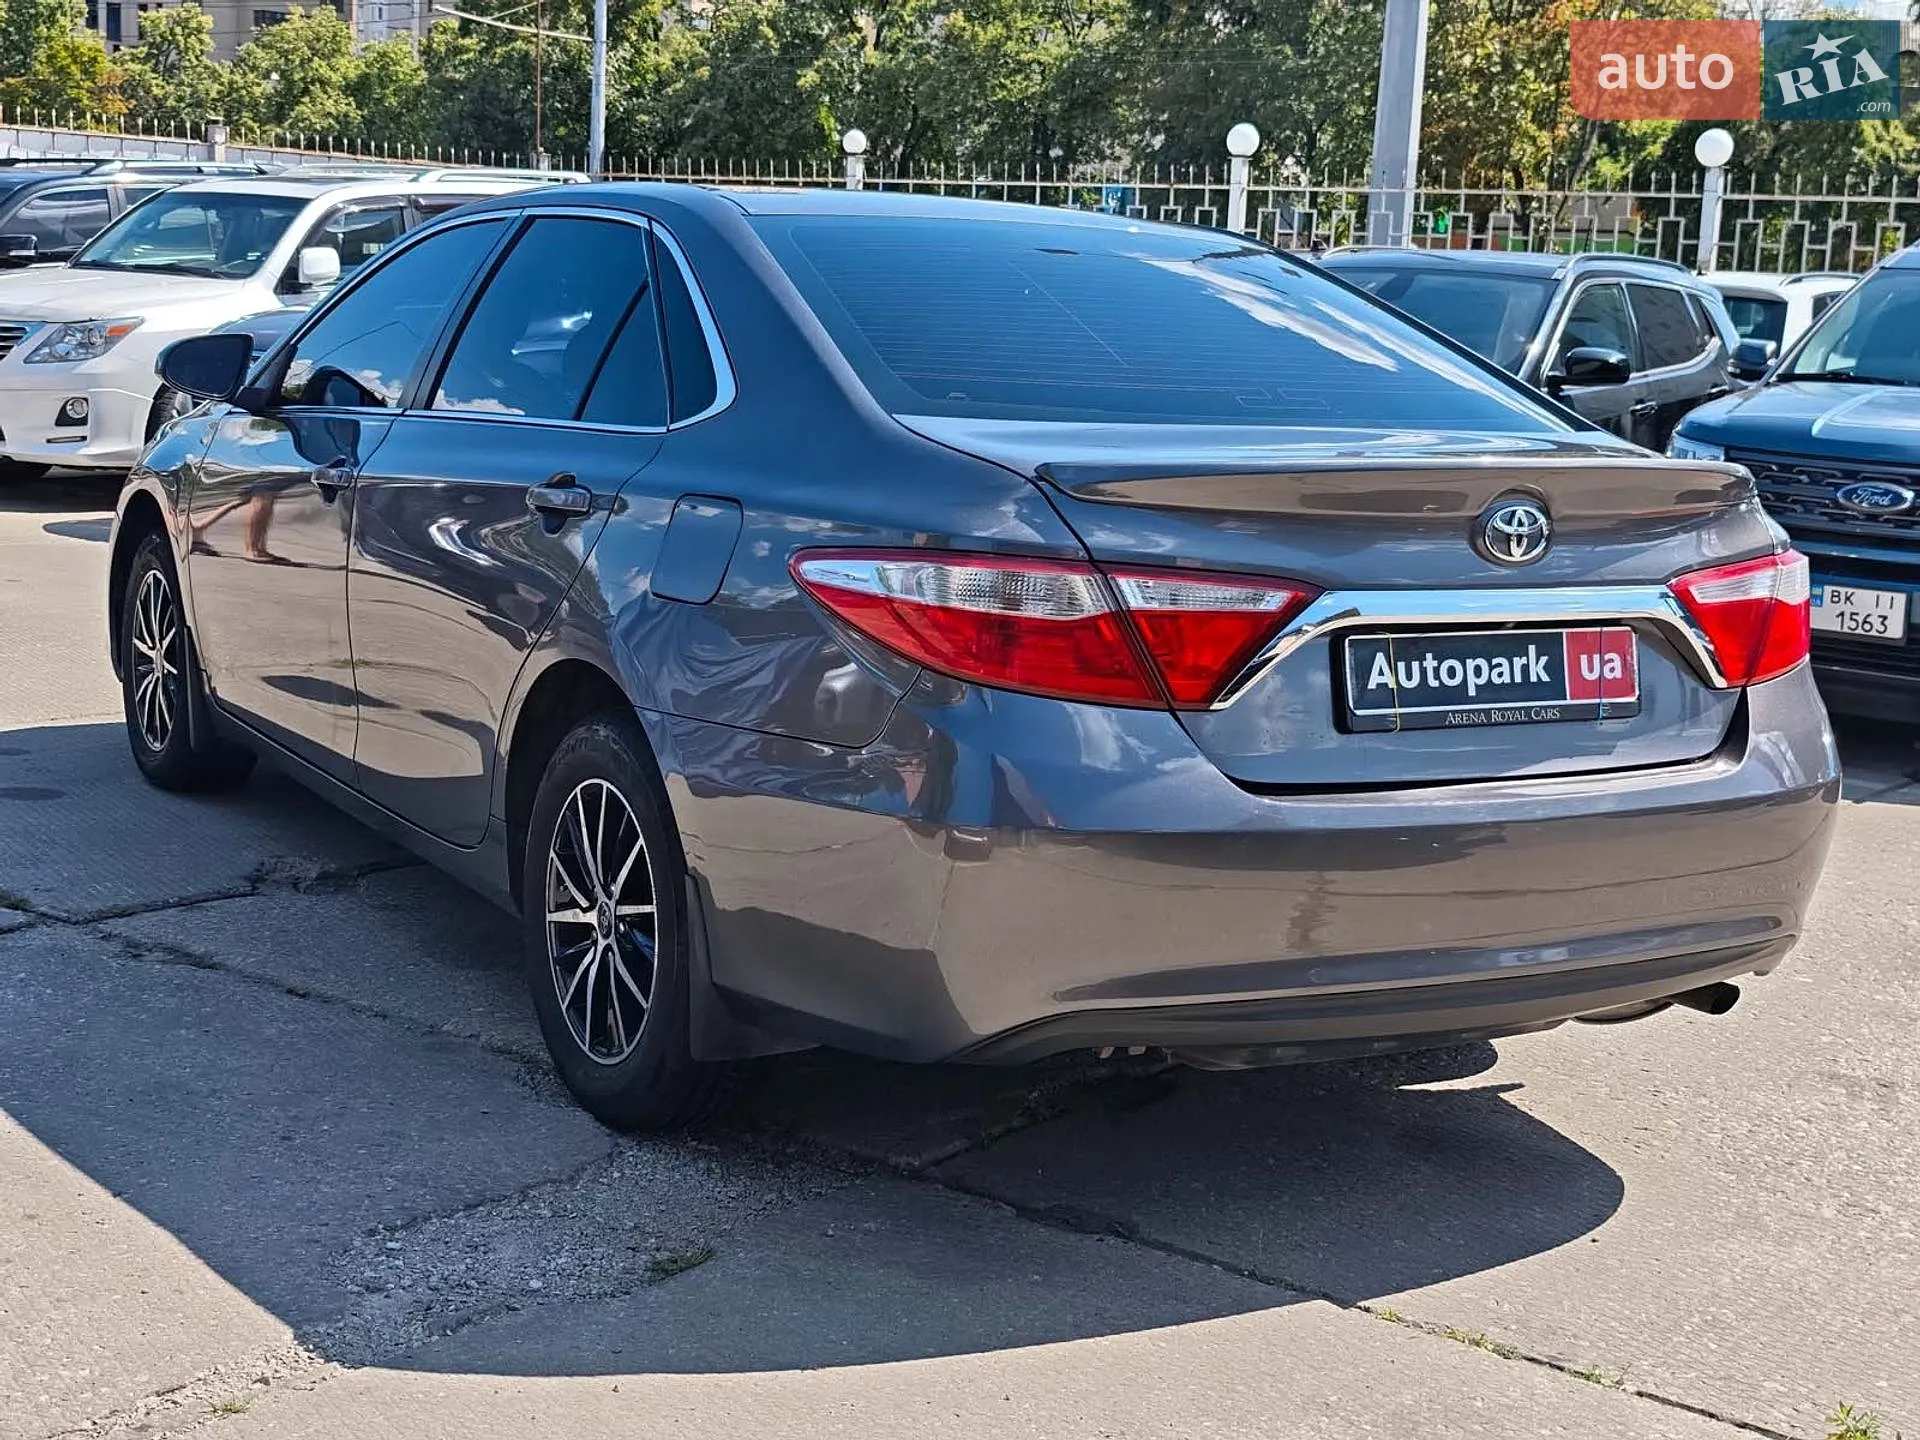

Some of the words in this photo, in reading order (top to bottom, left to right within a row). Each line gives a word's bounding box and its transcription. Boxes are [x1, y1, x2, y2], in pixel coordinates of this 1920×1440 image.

[1851, 487, 1893, 507] Ford
[1830, 589, 1855, 606] BK
[1835, 611, 1889, 635] 1563
[1367, 644, 1551, 696] Autopark
[1580, 651, 1623, 681] ua
[1445, 711, 1487, 725] ARENA
[1491, 709, 1528, 723] ROYAL
[1531, 707, 1560, 720] CARS
